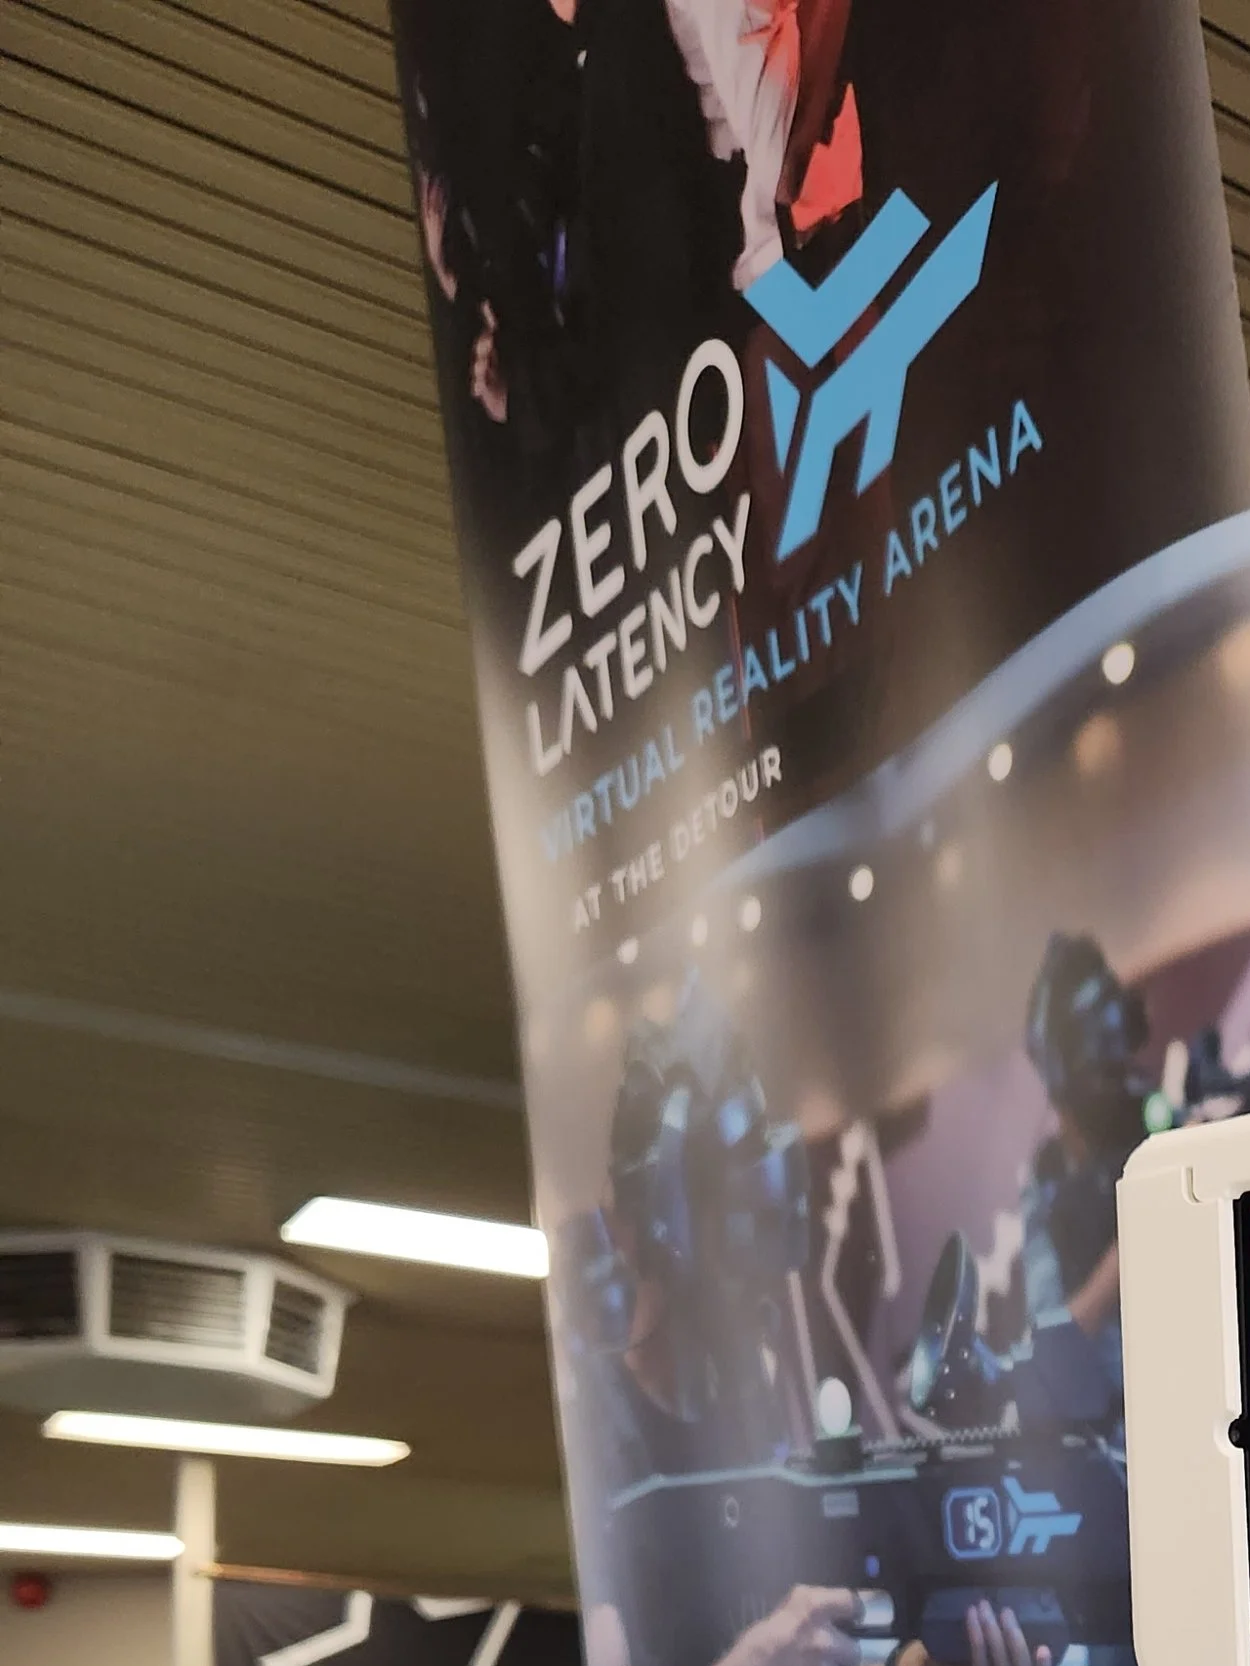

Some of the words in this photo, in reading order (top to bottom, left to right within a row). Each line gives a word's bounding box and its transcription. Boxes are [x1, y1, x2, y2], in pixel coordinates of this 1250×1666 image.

[511, 338, 745, 677] ZERO
[527, 492, 751, 778] LATENCY
[541, 722, 685, 862] VIRTUAL
[691, 560, 863, 742] REALITY
[883, 398, 1043, 598] ARENA
[573, 883, 601, 934] AT
[609, 839, 666, 905] THE
[668, 744, 782, 862] DETOUR
